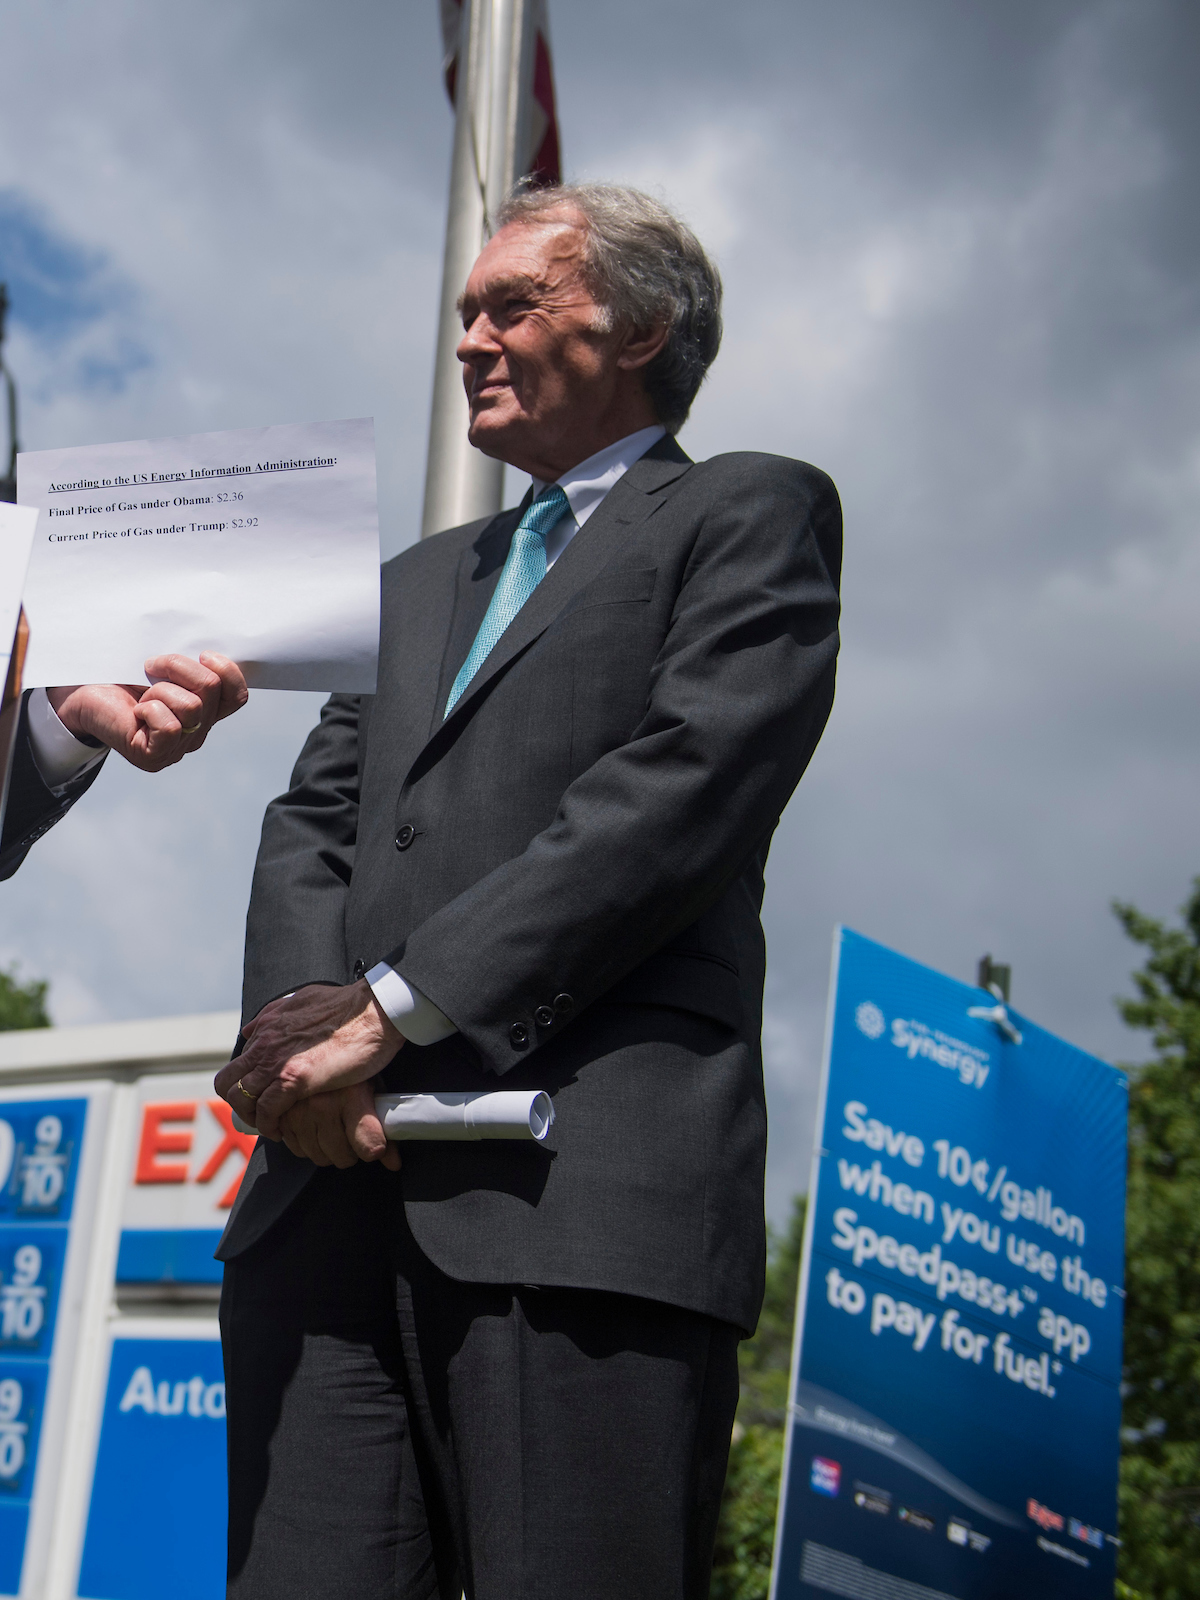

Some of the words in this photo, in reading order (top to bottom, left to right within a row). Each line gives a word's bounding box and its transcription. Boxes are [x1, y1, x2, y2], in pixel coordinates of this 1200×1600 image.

[48, 479, 100, 491] According
[102, 478, 112, 487] to
[114, 476, 130, 485] the
[133, 473, 148, 483] US
[151, 472, 187, 482] Energy
[190, 464, 251, 478] Information
[254, 456, 338, 472] Administration:
[48, 532, 89, 542] Current
[92, 530, 118, 540] Price
[121, 528, 132, 538] of
[133, 527, 153, 536] Gas
[156, 524, 187, 534] under
[189, 521, 229, 533] Trump:
[231, 517, 259, 529] $2.92
[49, 507, 74, 517] Final
[77, 505, 103, 515] Price
[105, 503, 117, 512] of
[118, 502, 138, 511] Gas
[140, 499, 171, 509] under
[173, 496, 214, 506] Obama:
[216, 491, 244, 503] $2.36
[891, 1018, 990, 1089] Synergy
[842, 1100, 925, 1168] Save
[933, 1139, 1086, 1247] 10¢/gallon
[838, 1158, 935, 1225] when
[940, 1202, 1001, 1254] you
[1006, 1233, 1057, 1282] use
[1061, 1254, 1107, 1309] the
[826, 1267, 866, 1315] to
[870, 1293, 936, 1351] pay
[941, 1308, 989, 1365] for
[1038, 1306, 1091, 1363] app
[119, 1366, 226, 1418] Auto
